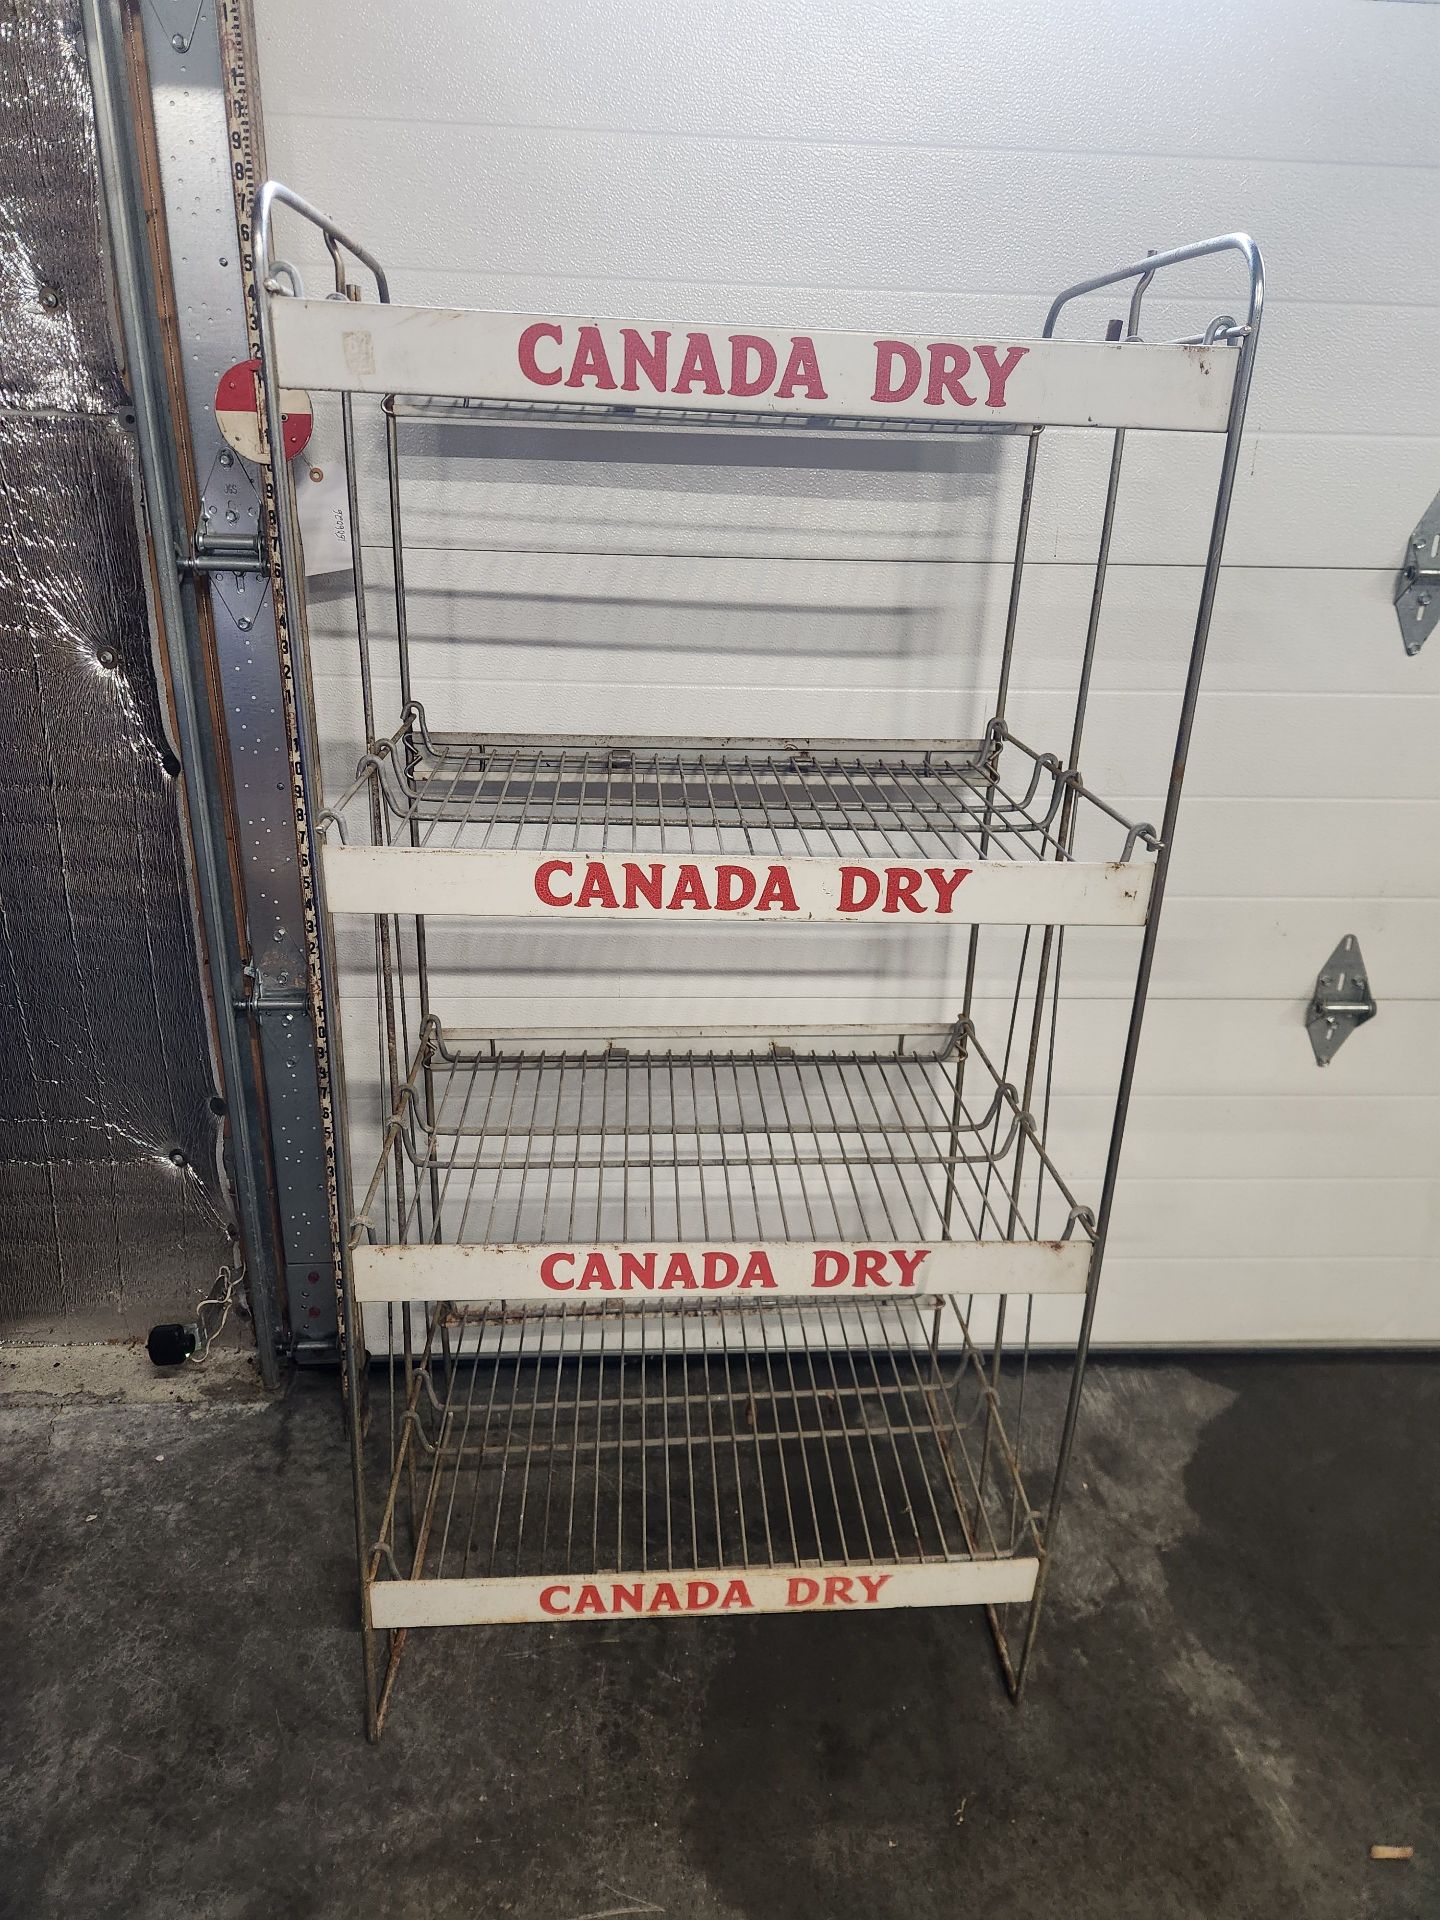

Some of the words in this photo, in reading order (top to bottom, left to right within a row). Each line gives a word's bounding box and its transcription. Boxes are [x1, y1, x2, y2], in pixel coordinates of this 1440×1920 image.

[232, 131, 241, 149] 9
[235, 162, 244, 180] 8
[240, 223, 250, 242] 6
[244, 254, 253, 271] 5
[249, 314, 258, 331] 3
[518, 323, 828, 400] CANADA
[871, 340, 1029, 408] DRY
[274, 563, 281, 578] 6
[281, 640, 289, 654] 3
[284, 664, 292, 679] 2
[294, 784, 302, 798] 9
[296, 808, 304, 821] 8
[298, 831, 305, 844] 7
[301, 854, 309, 867] 6
[303, 876, 310, 889] 5
[534, 860, 800, 912] CANADA
[837, 866, 973, 914] DRY
[306, 920, 314, 933] 3
[309, 942, 316, 954] 2
[320, 1087, 328, 1099] 7
[322, 1107, 330, 1119] 6
[324, 1127, 331, 1139] 5
[326, 1146, 333, 1158] 4
[327, 1166, 335, 1178] 3
[540, 1250, 778, 1291] CANADA
[811, 1249, 931, 1288] DRY
[335, 1279, 342, 1289] 9
[539, 1579, 754, 1616] CANADA
[784, 1574, 893, 1608] DRY
